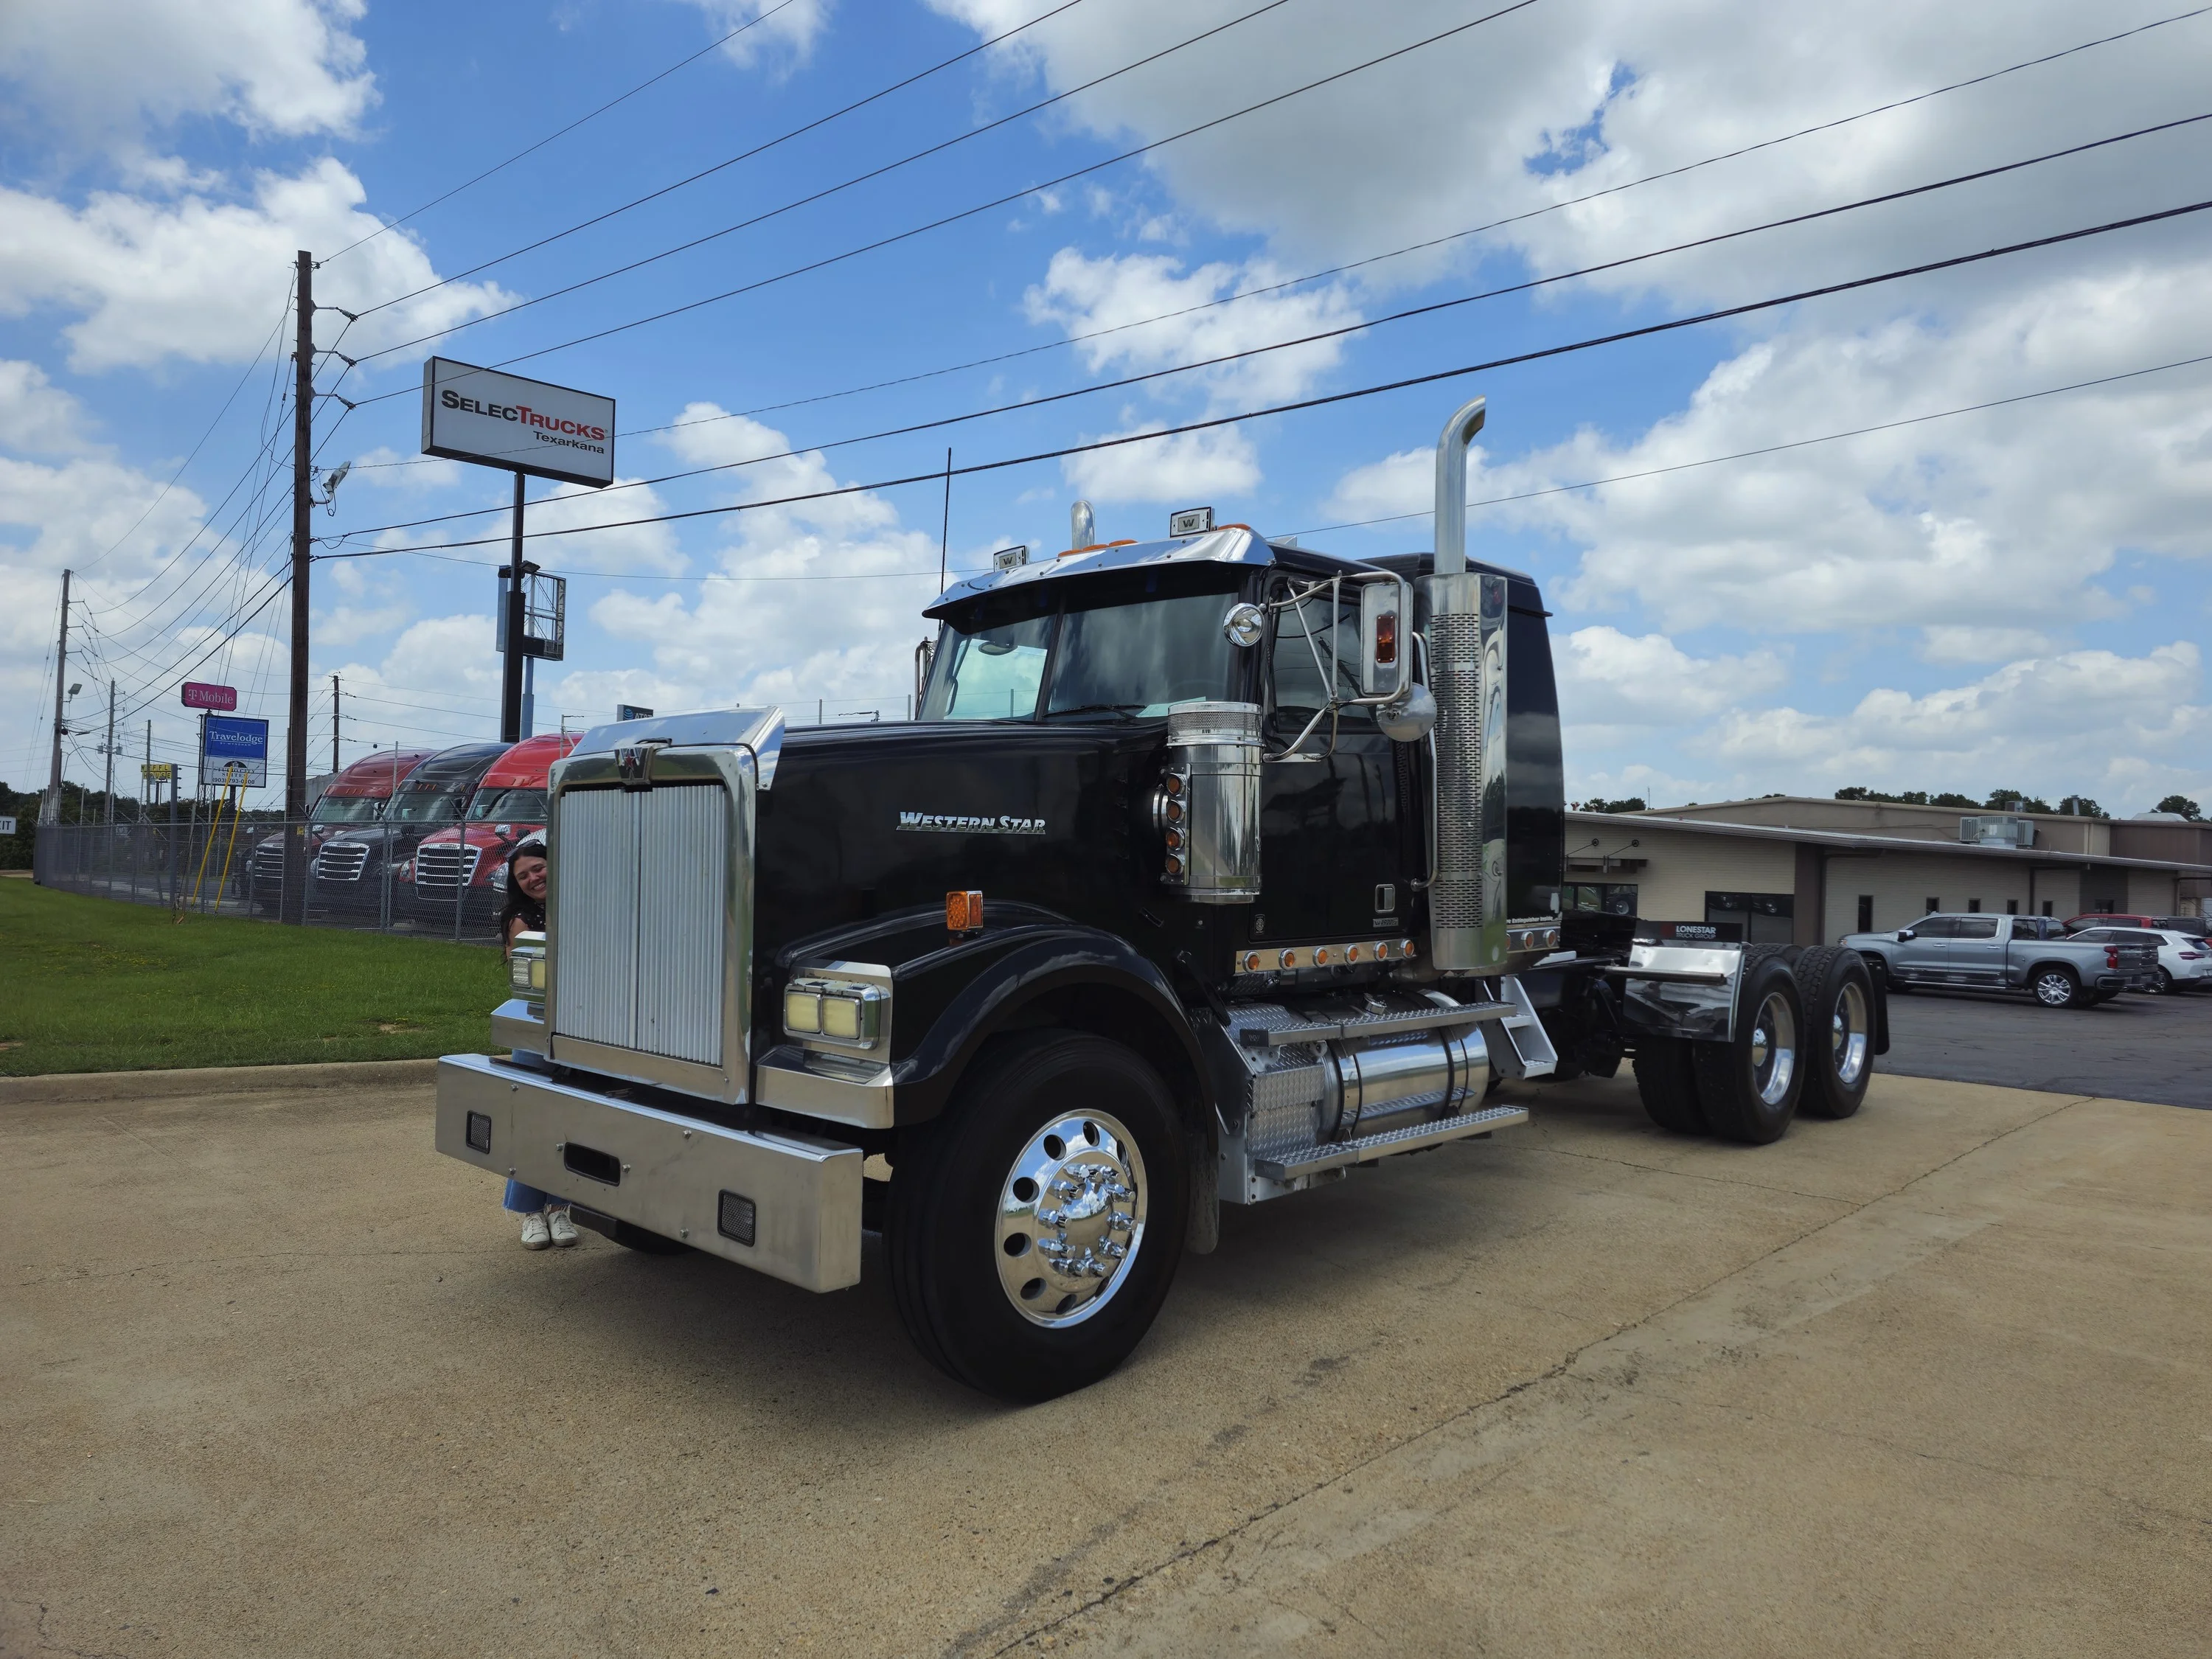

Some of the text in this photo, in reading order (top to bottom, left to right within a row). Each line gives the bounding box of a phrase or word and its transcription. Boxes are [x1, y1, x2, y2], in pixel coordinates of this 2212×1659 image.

[533, 431, 605, 454] Texarkana
[199, 690, 234, 705] Mobile
[209, 731, 263, 745] Travelodge
[0, 820, 12, 830] IT
[899, 811, 1046, 833] WESTERN STAR
[1675, 925, 1717, 934] LONESTAR
